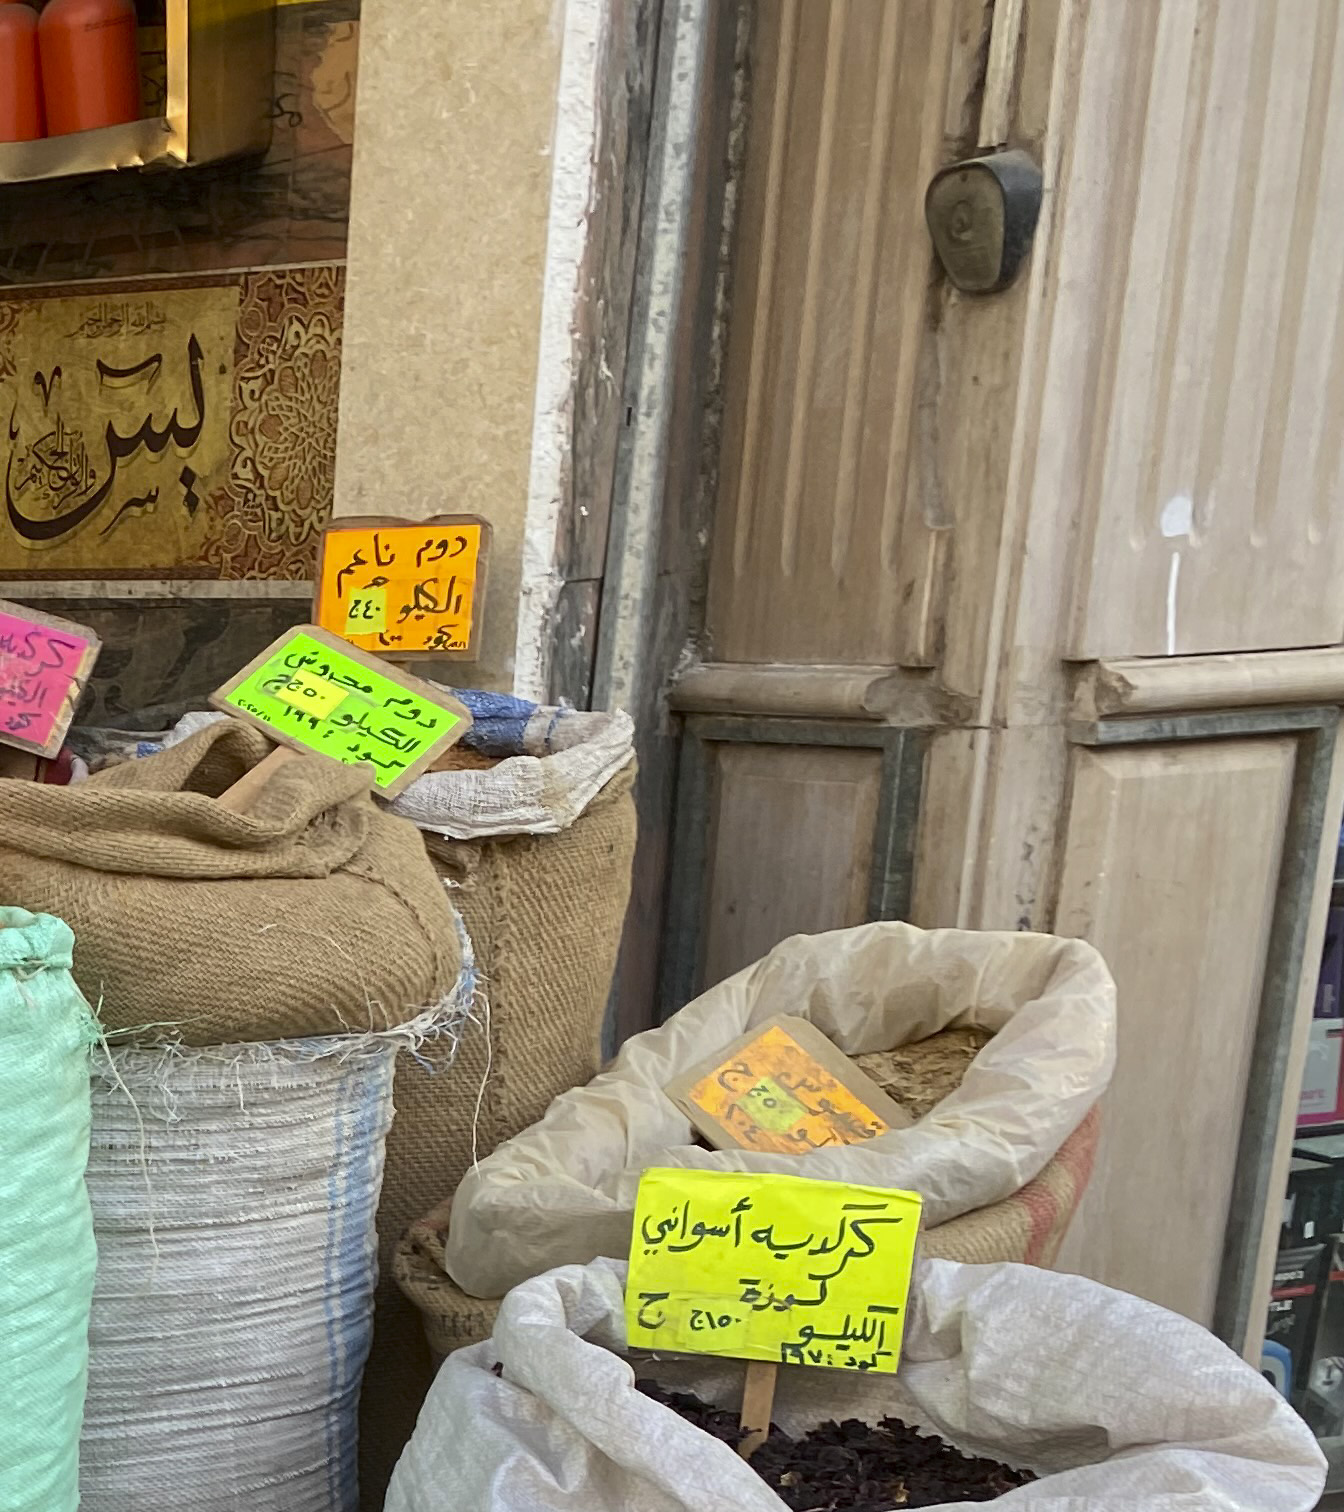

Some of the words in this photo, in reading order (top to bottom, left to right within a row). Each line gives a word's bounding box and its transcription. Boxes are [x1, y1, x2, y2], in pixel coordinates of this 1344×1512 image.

[336, 533, 397, 599] ناعم
[415, 534, 469, 569] دوم
[397, 576, 463, 624] الكيلو
[326, 706, 421, 753] الكيلو
[382, 695, 439, 730] دوم
